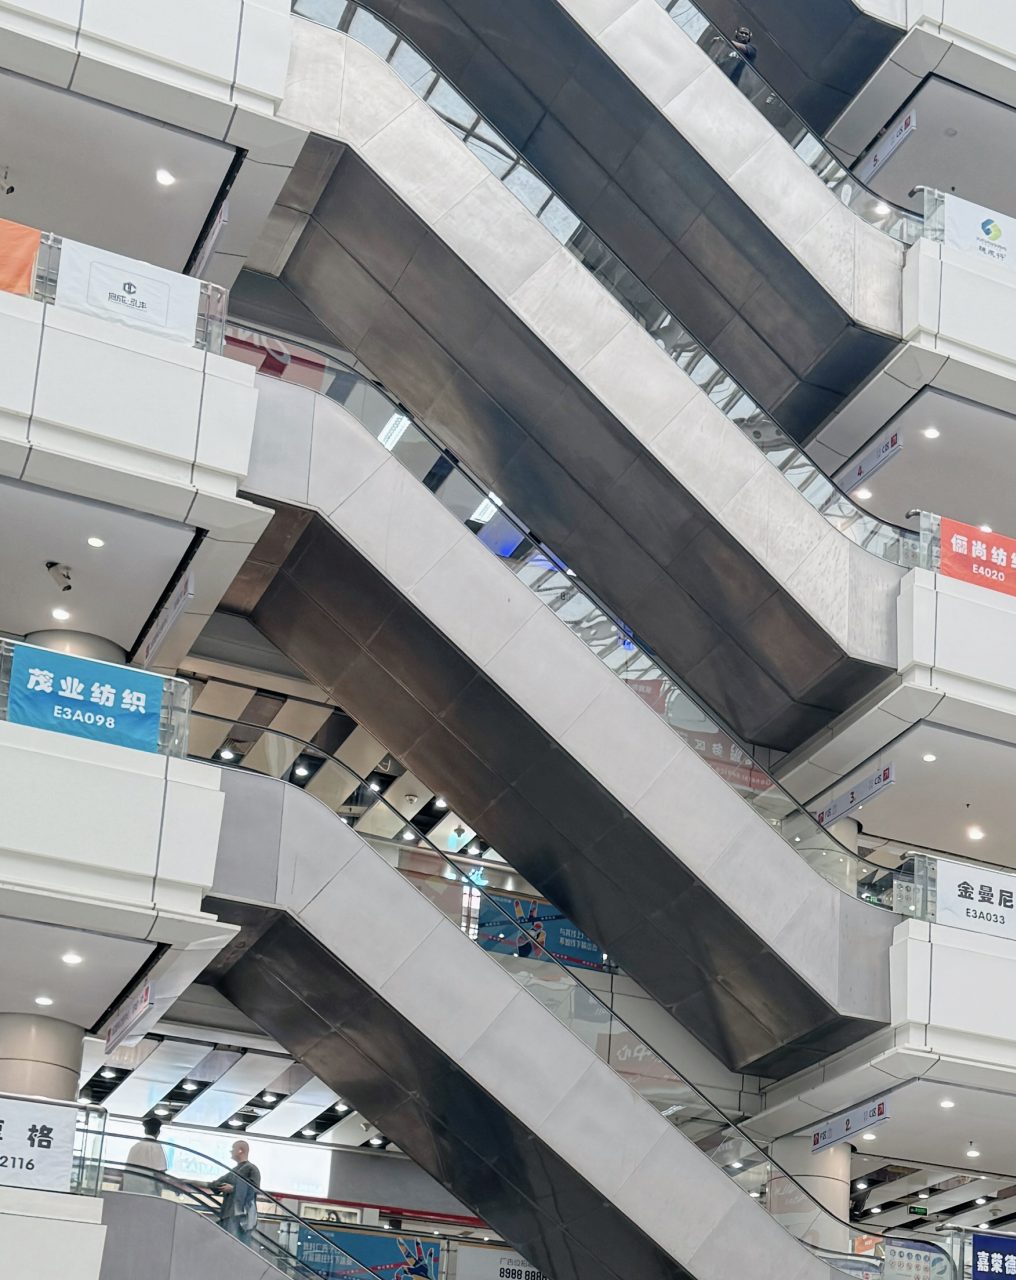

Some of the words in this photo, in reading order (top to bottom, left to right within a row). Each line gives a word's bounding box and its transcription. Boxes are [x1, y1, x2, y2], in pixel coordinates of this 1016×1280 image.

[972, 564, 1005, 583] E4020
[27, 668, 146, 714] 茂业纺织
[53, 706, 115, 729] E3A098
[958, 881, 1014, 909] 金曼尼
[966, 908, 1005, 925] E3A033
[500, 1268, 522, 1280] 8988
